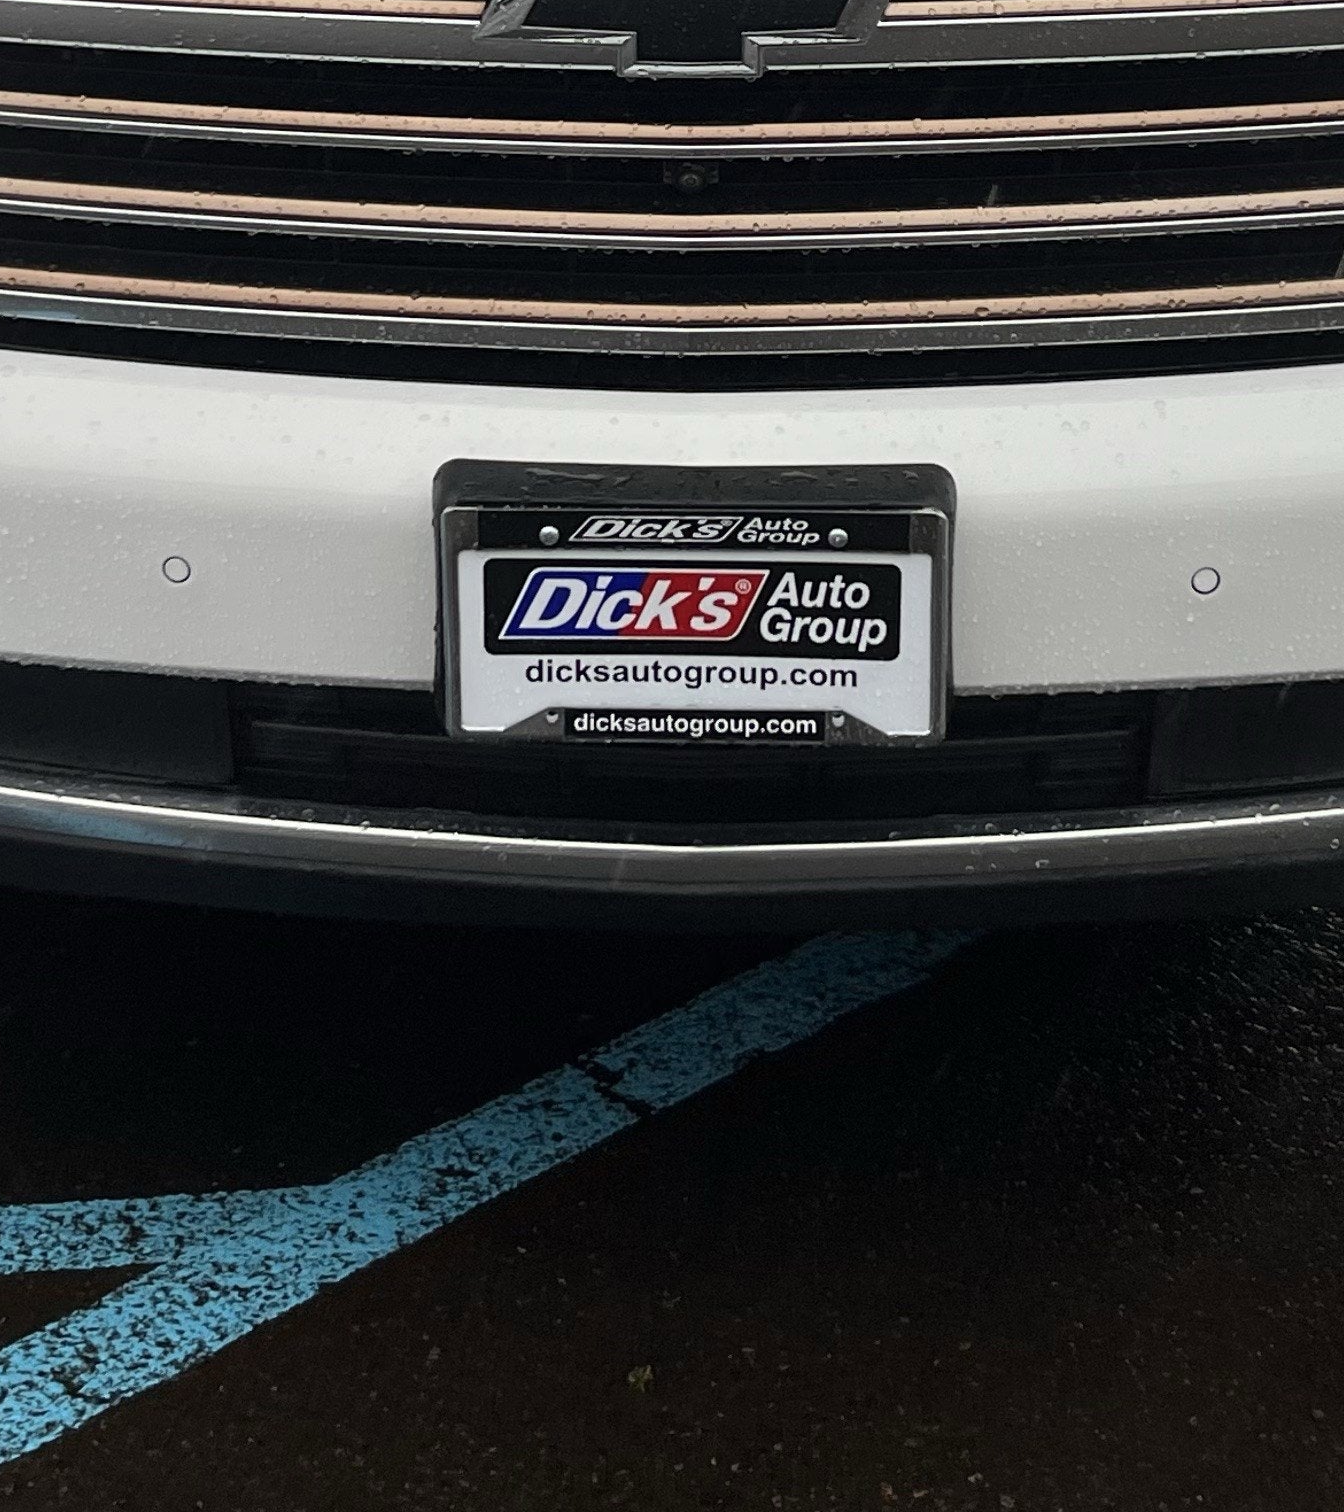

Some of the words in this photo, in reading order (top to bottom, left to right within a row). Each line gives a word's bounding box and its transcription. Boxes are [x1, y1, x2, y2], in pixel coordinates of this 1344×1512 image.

[743, 517, 809, 531] Auto
[737, 530, 820, 546] Group
[767, 572, 870, 609] Auto
[760, 607, 888, 652] Group
[525, 659, 858, 689] dicksautogroup.com
[573, 713, 817, 736] dicksautogroup.com
